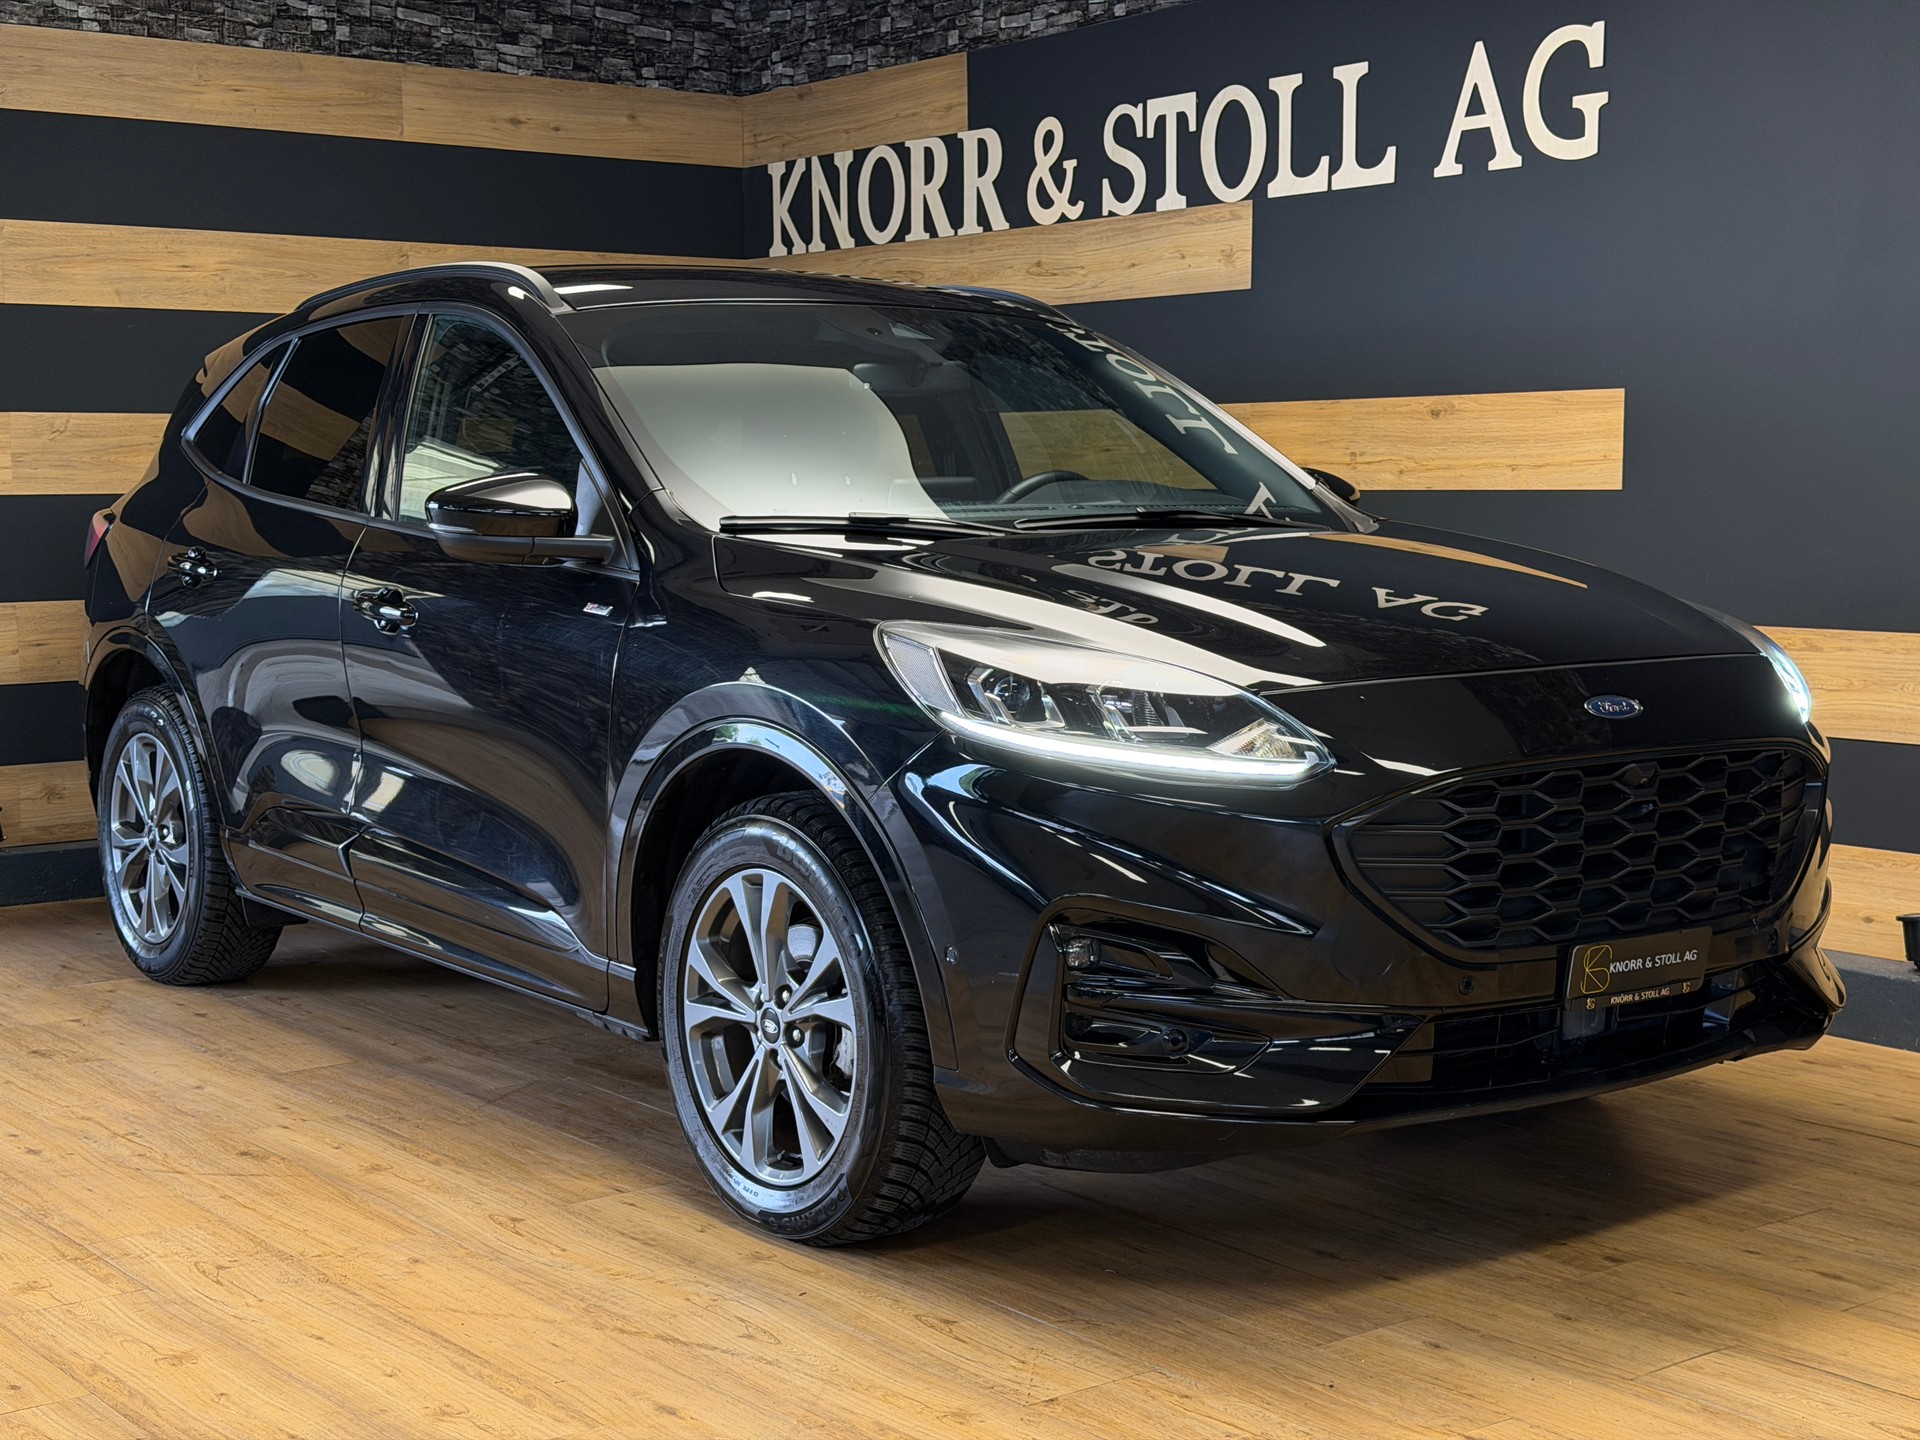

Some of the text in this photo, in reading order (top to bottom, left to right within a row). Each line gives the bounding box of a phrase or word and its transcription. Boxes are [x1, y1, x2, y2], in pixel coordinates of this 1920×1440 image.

[768, 21, 1610, 258] KNORR & STOLL AG
[1609, 949, 1698, 974] KNORR & STOLL AG
[1634, 993, 1640, 1001] &
[1641, 990, 1660, 1000] STOLL
[1660, 987, 1670, 996] AG
